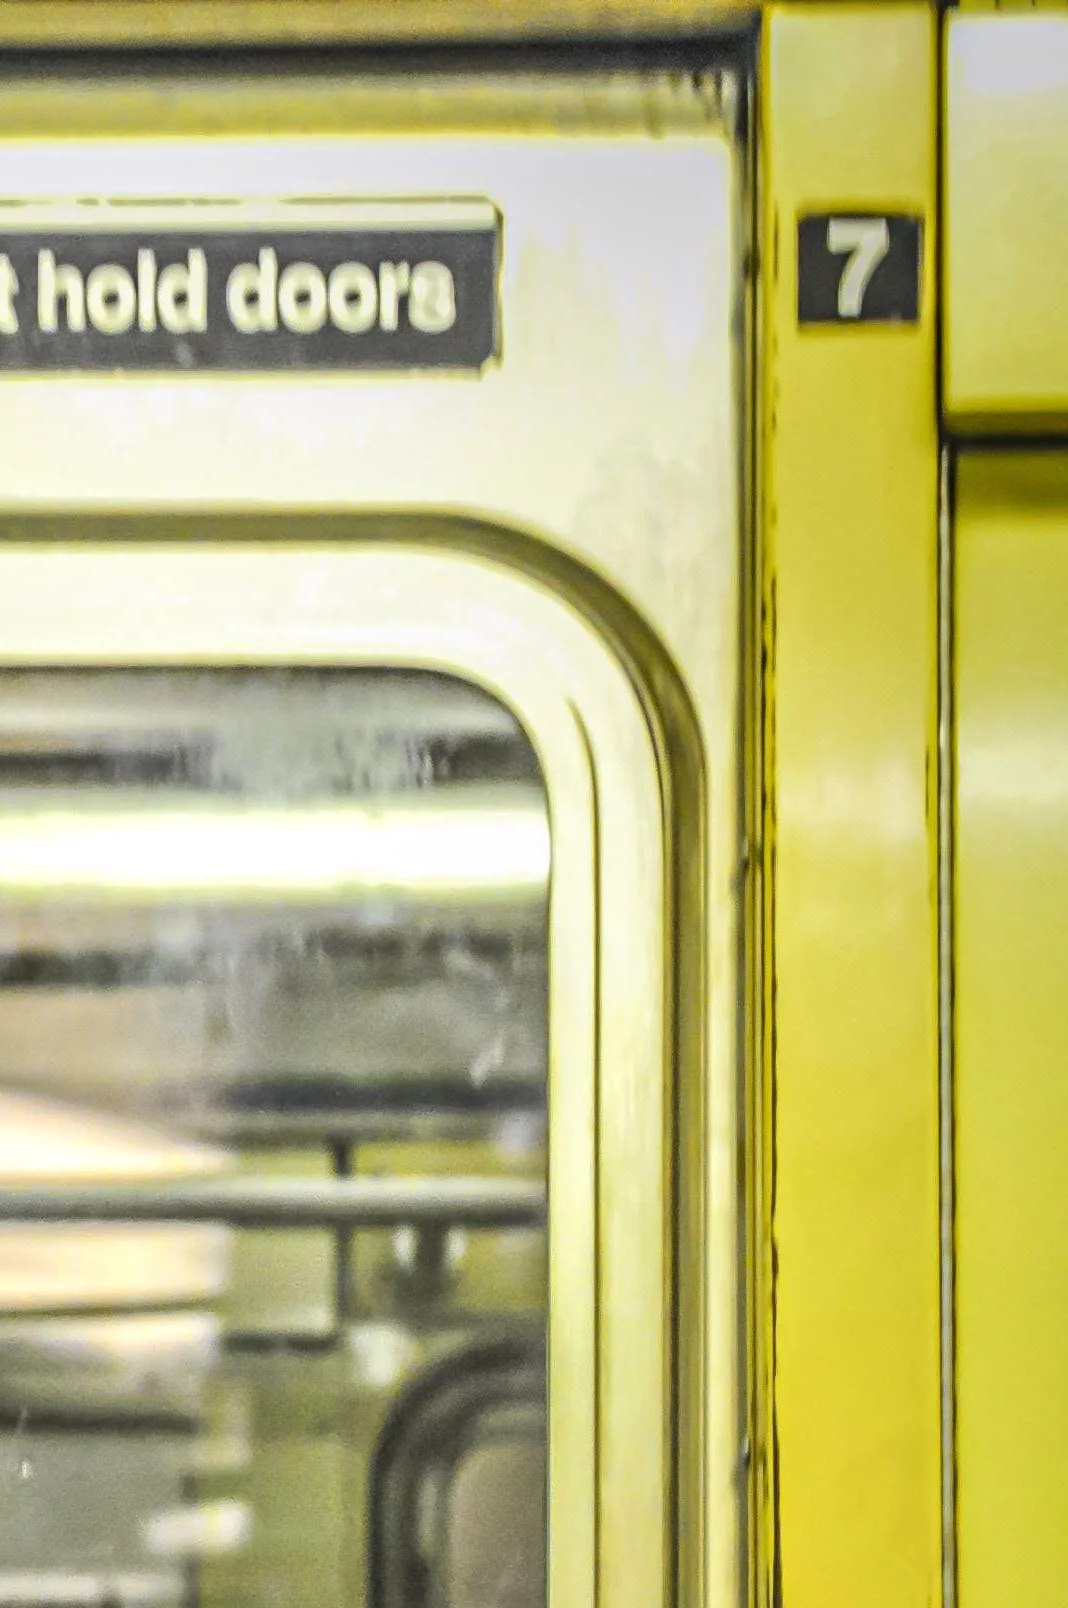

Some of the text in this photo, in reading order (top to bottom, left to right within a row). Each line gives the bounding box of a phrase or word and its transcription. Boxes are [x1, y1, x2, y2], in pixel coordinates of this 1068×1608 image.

[37, 247, 208, 335] hold
[226, 246, 457, 335] doors
[827, 217, 890, 319] 7
